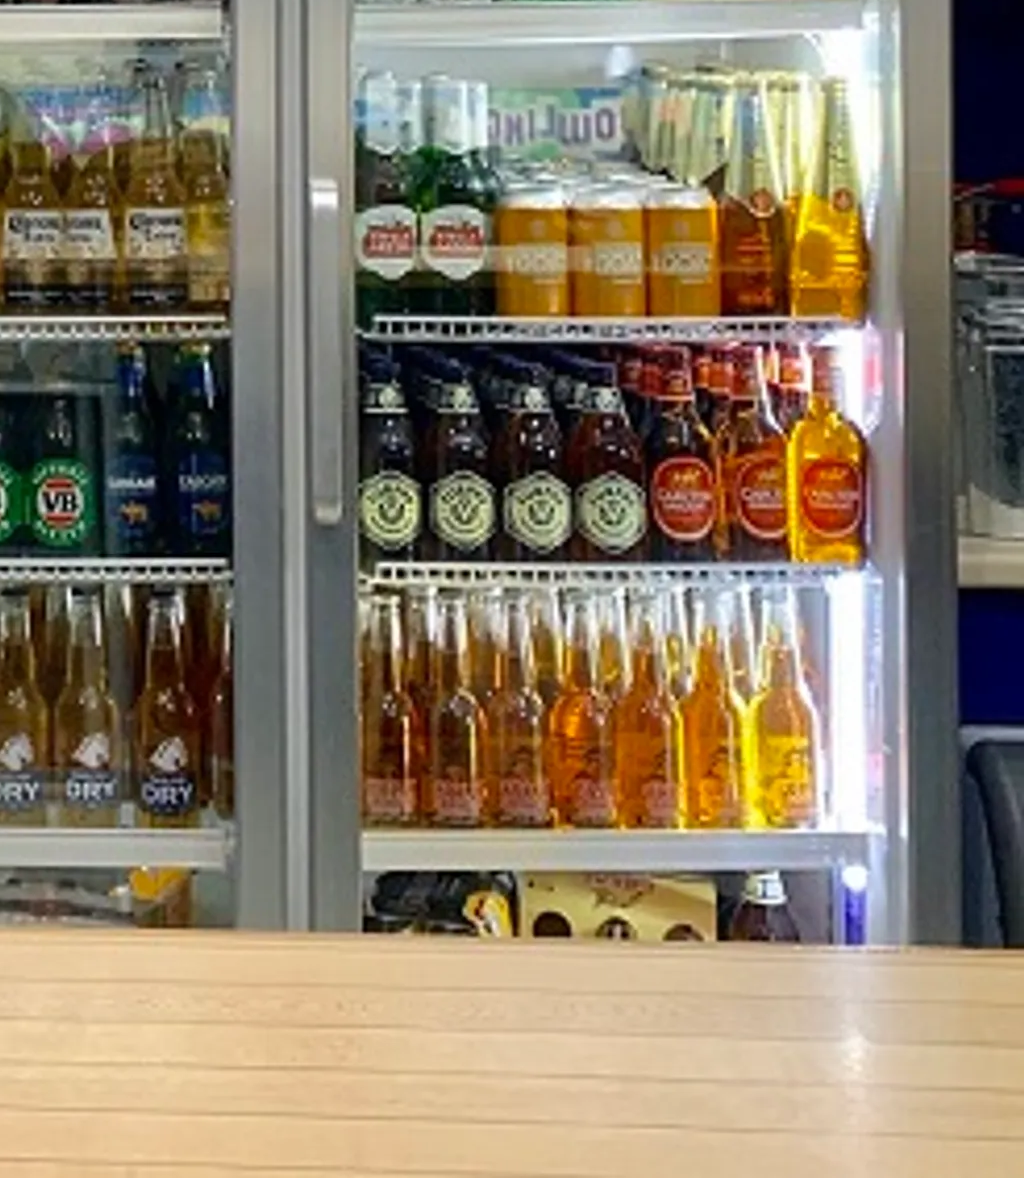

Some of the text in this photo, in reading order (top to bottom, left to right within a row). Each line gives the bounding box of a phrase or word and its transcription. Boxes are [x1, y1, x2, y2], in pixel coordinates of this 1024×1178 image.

[42, 491, 80, 512] VB
[65, 779, 118, 802] DRY
[141, 783, 194, 806] DRY
